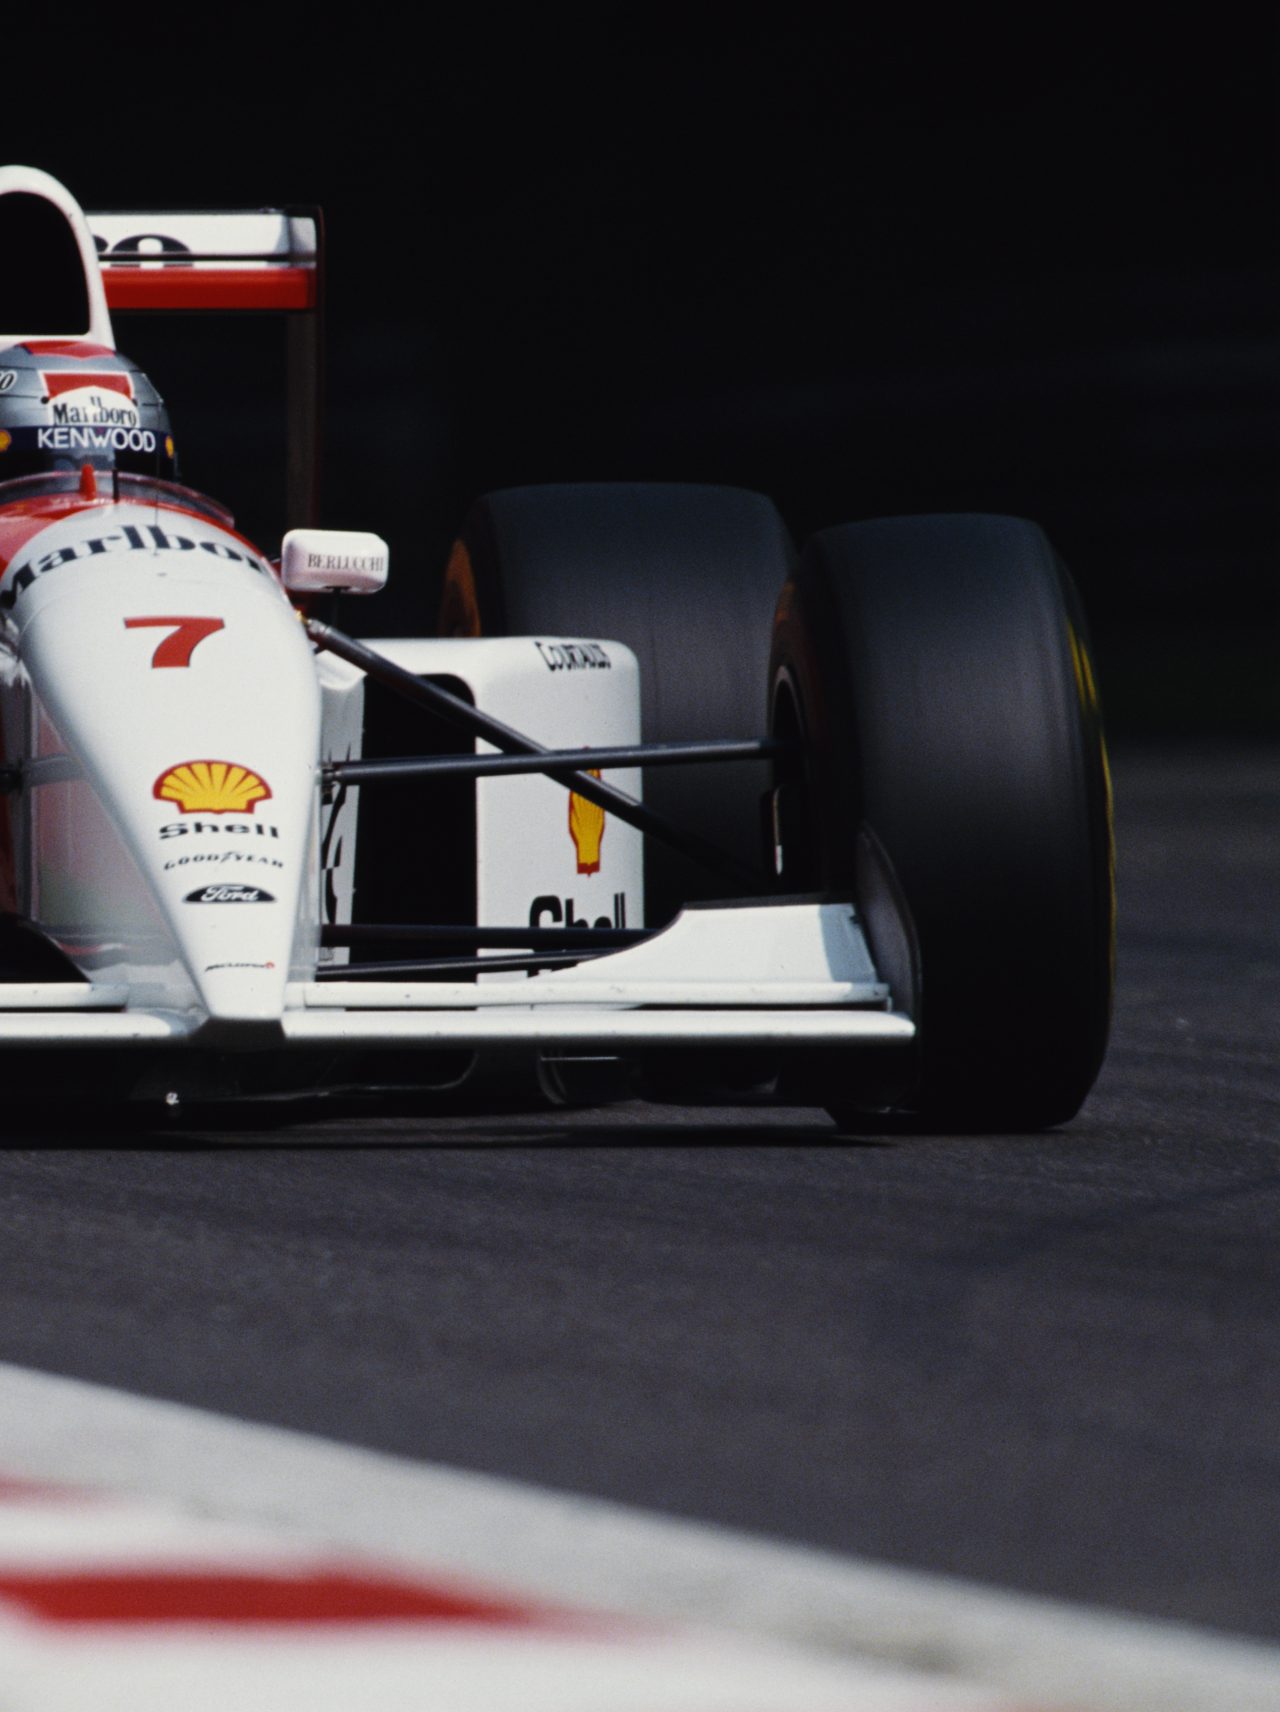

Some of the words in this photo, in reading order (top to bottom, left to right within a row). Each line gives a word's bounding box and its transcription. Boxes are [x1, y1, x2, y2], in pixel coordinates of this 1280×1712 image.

[38, 427, 156, 453] KENWOOD
[123, 616, 225, 669] 7
[159, 822, 279, 840] Shell
[164, 851, 284, 871] GOODYEAR
[200, 885, 260, 902] Ford
